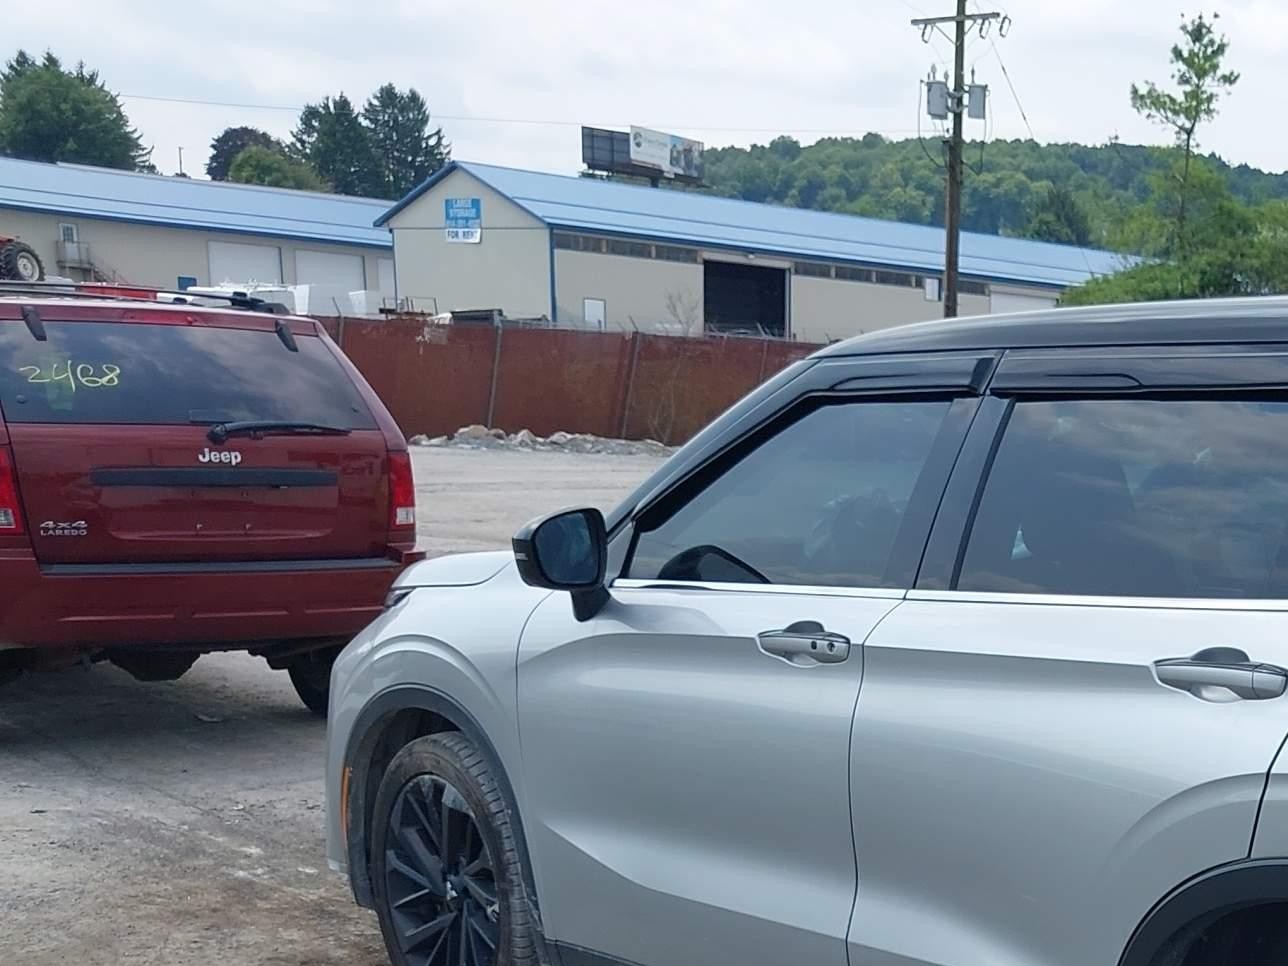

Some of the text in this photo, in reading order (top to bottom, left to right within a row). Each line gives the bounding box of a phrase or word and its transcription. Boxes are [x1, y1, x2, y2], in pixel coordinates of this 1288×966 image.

[19, 359, 121, 393] 2468
[198, 447, 242, 466] Jeep
[40, 520, 88, 529] 4x4
